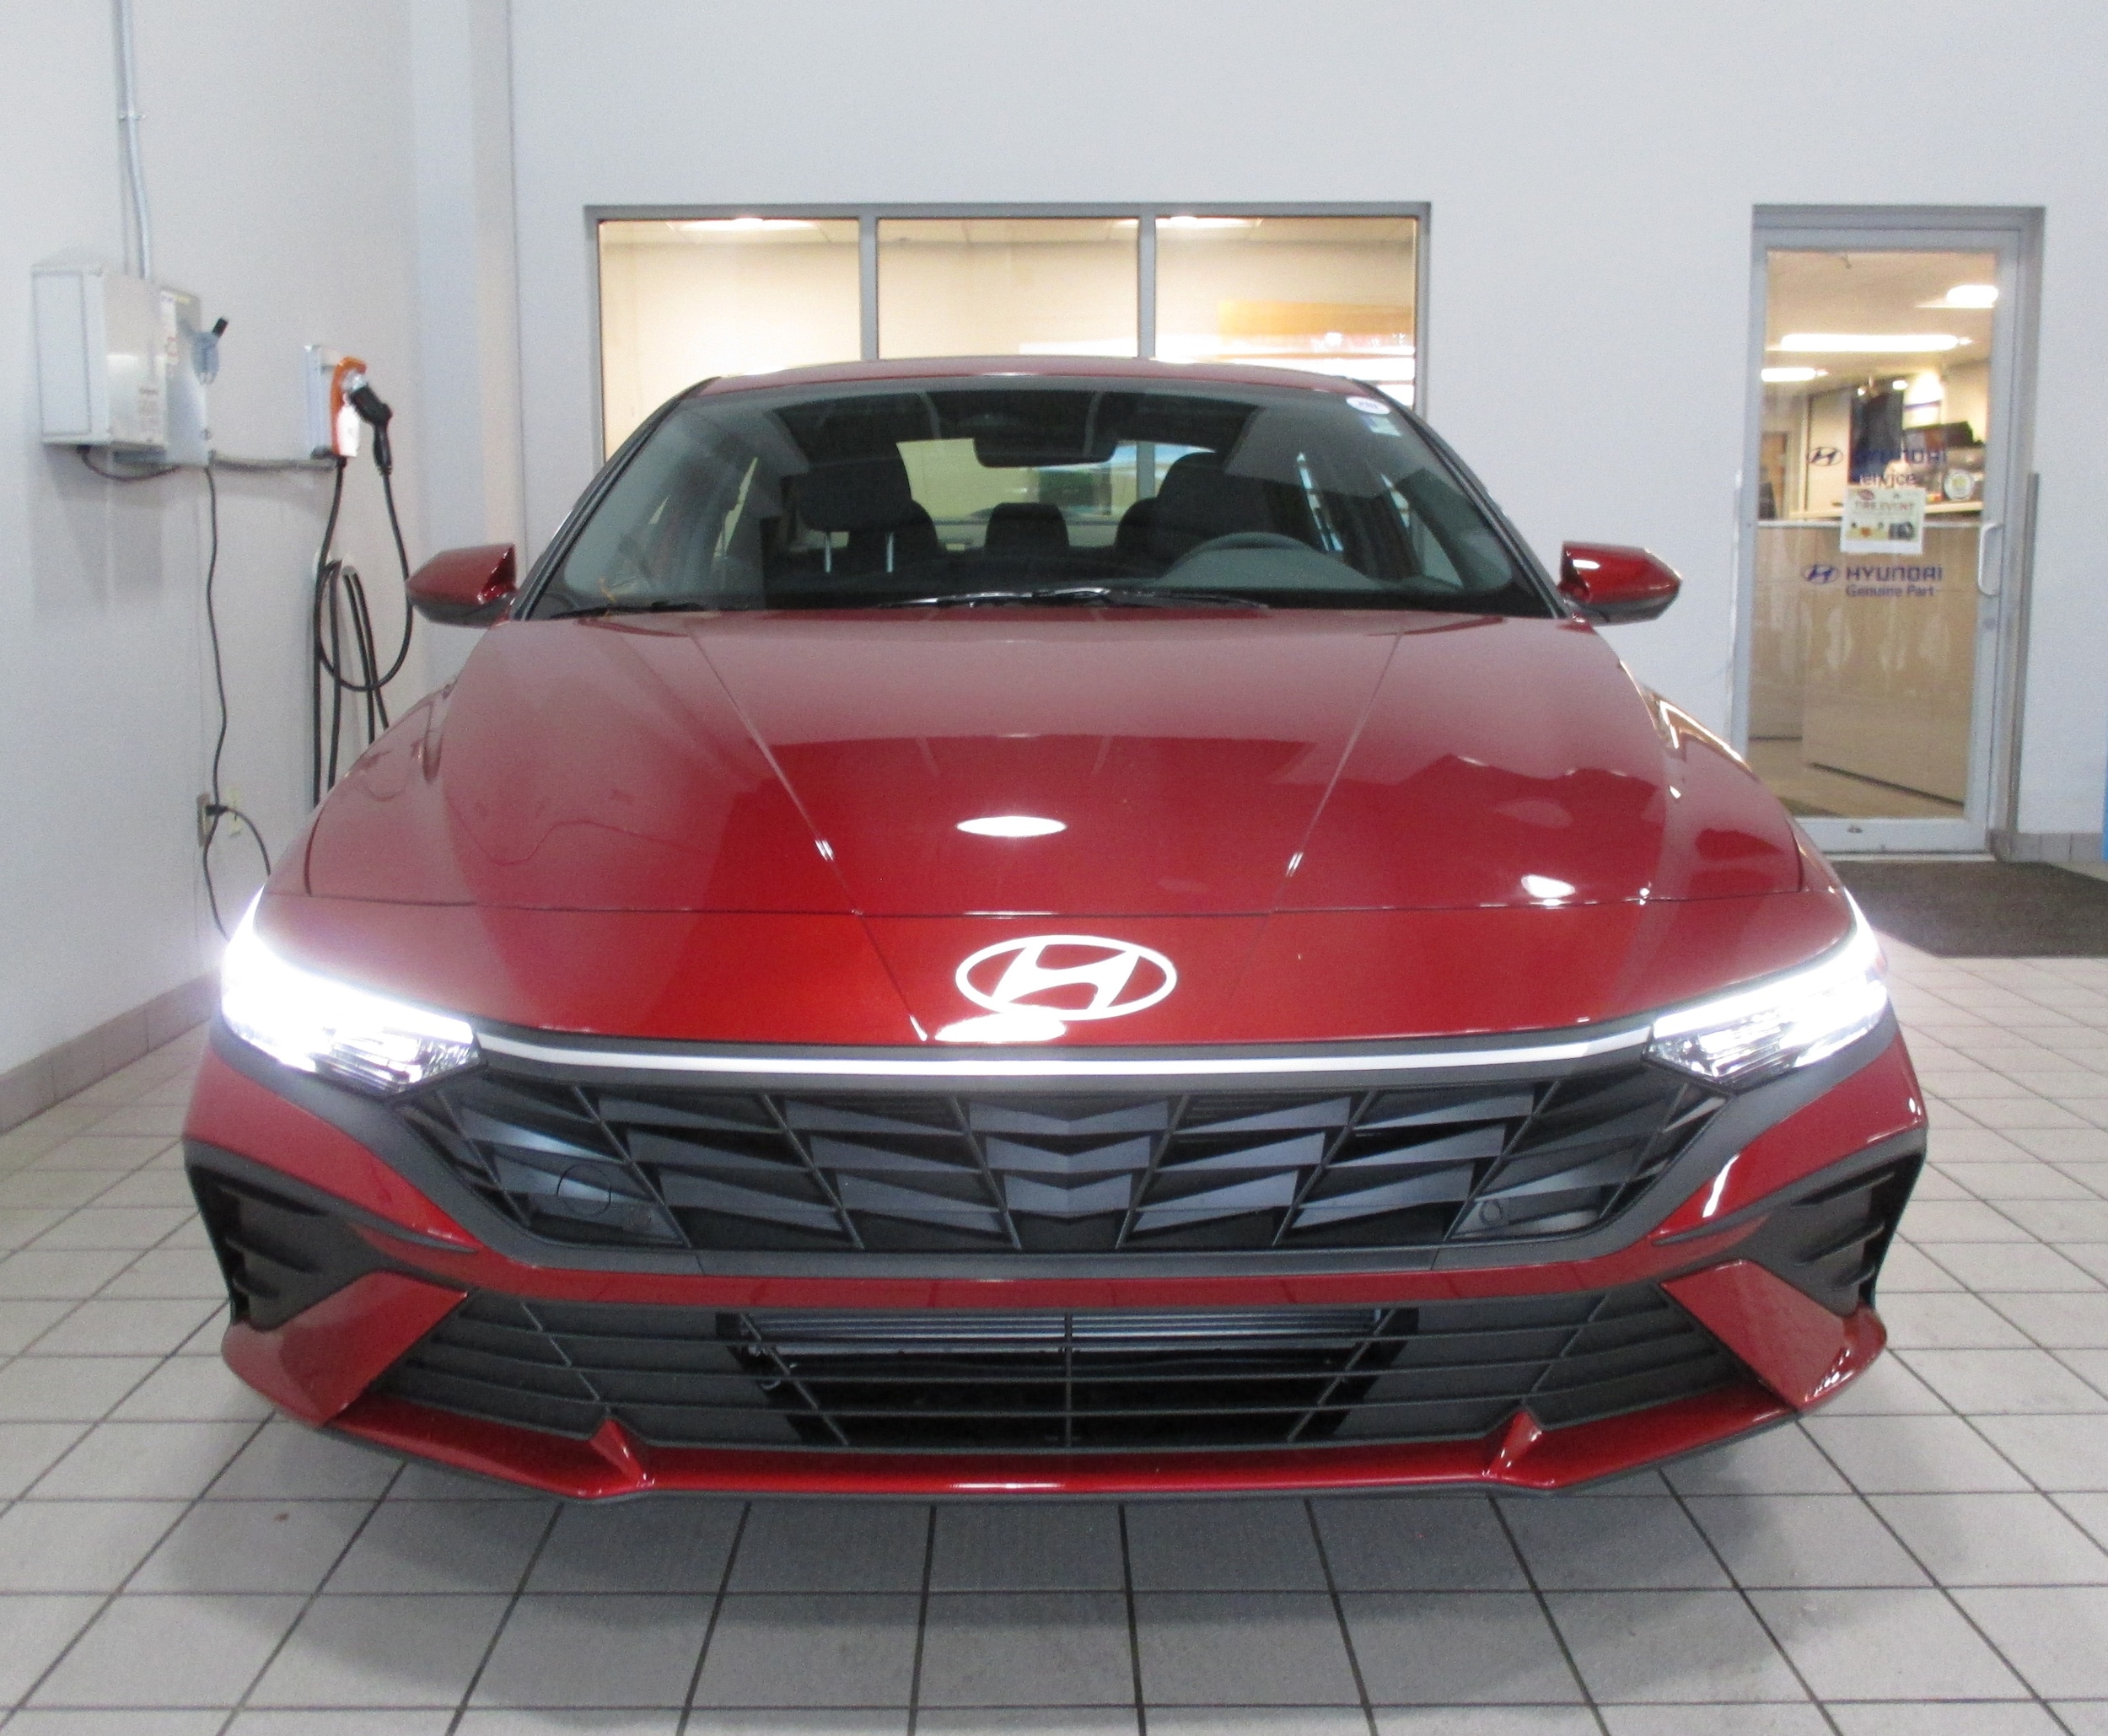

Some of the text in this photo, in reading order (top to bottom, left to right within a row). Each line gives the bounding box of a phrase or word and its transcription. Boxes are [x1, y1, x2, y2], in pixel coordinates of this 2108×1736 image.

[1846, 566, 1943, 581] HYUNDAI
[1846, 584, 1934, 597] Genuine Part
